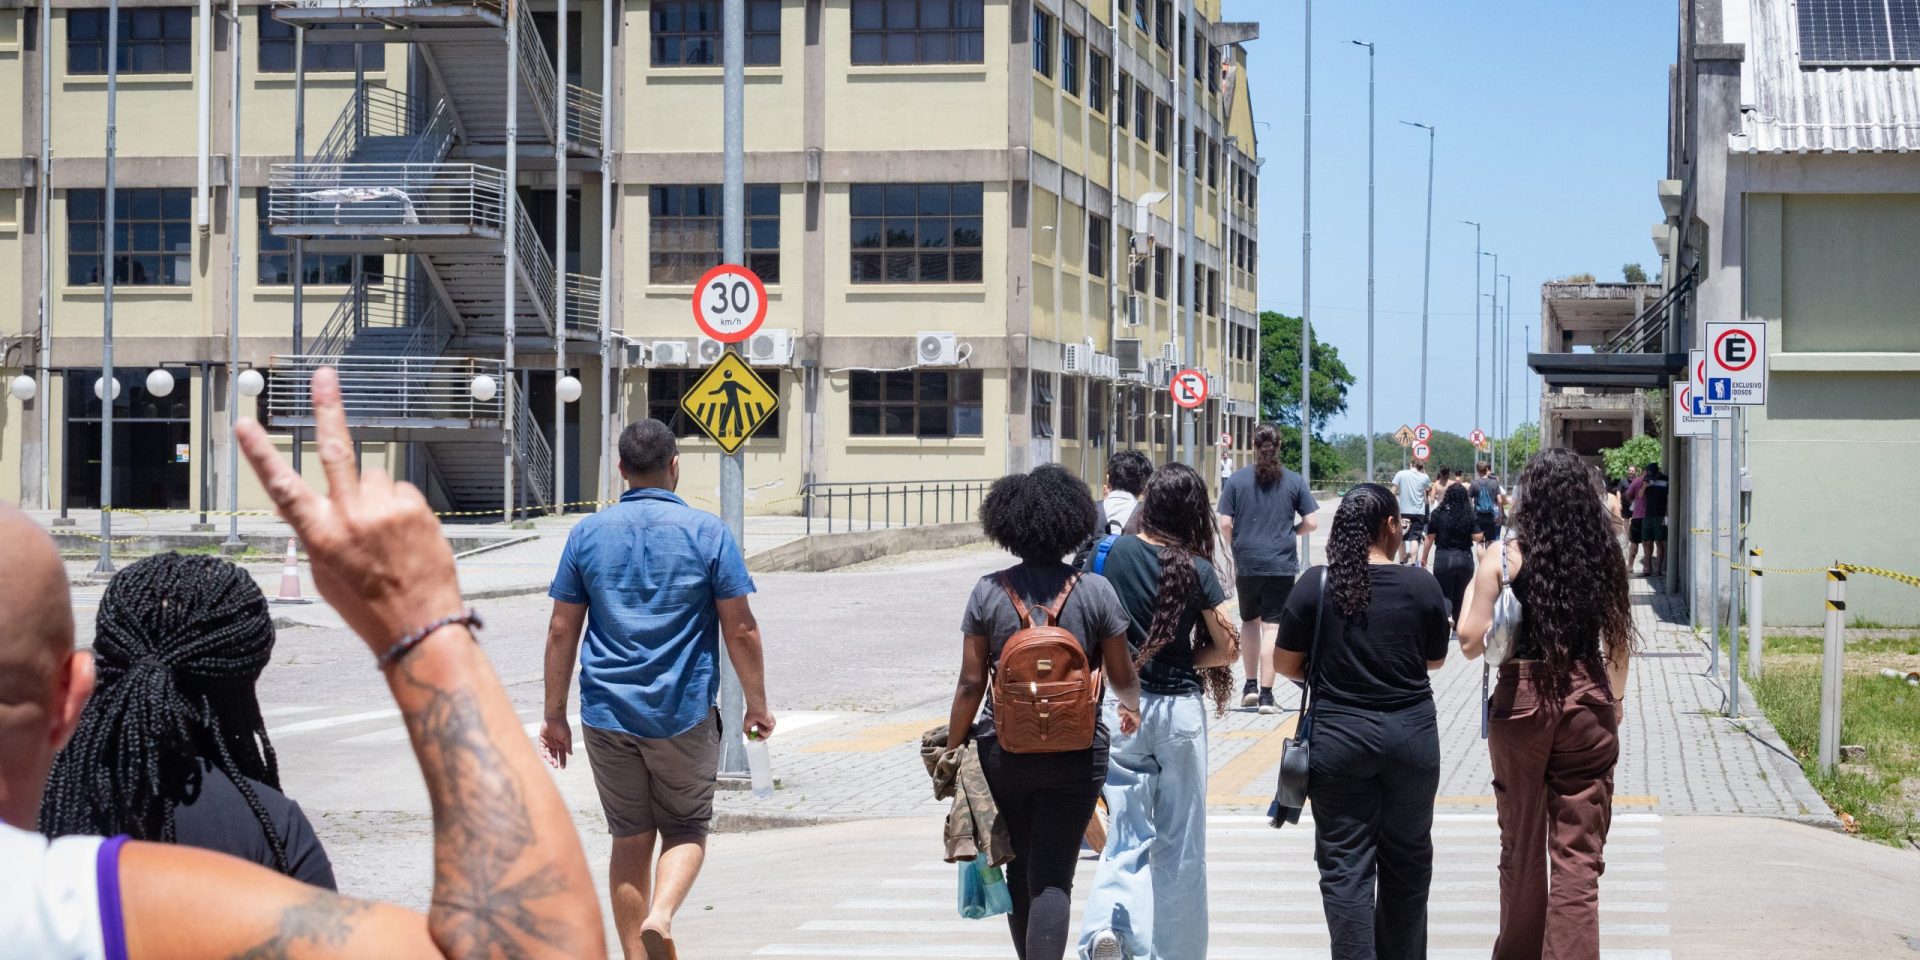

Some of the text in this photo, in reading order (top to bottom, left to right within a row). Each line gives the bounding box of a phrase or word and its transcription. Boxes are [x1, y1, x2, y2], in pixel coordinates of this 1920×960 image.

[711, 281, 750, 314] 30
[720, 317, 742, 326] km/h
[1725, 338, 1746, 362] E
[1182, 378, 1196, 399] E
[1419, 428, 1425, 439] E
